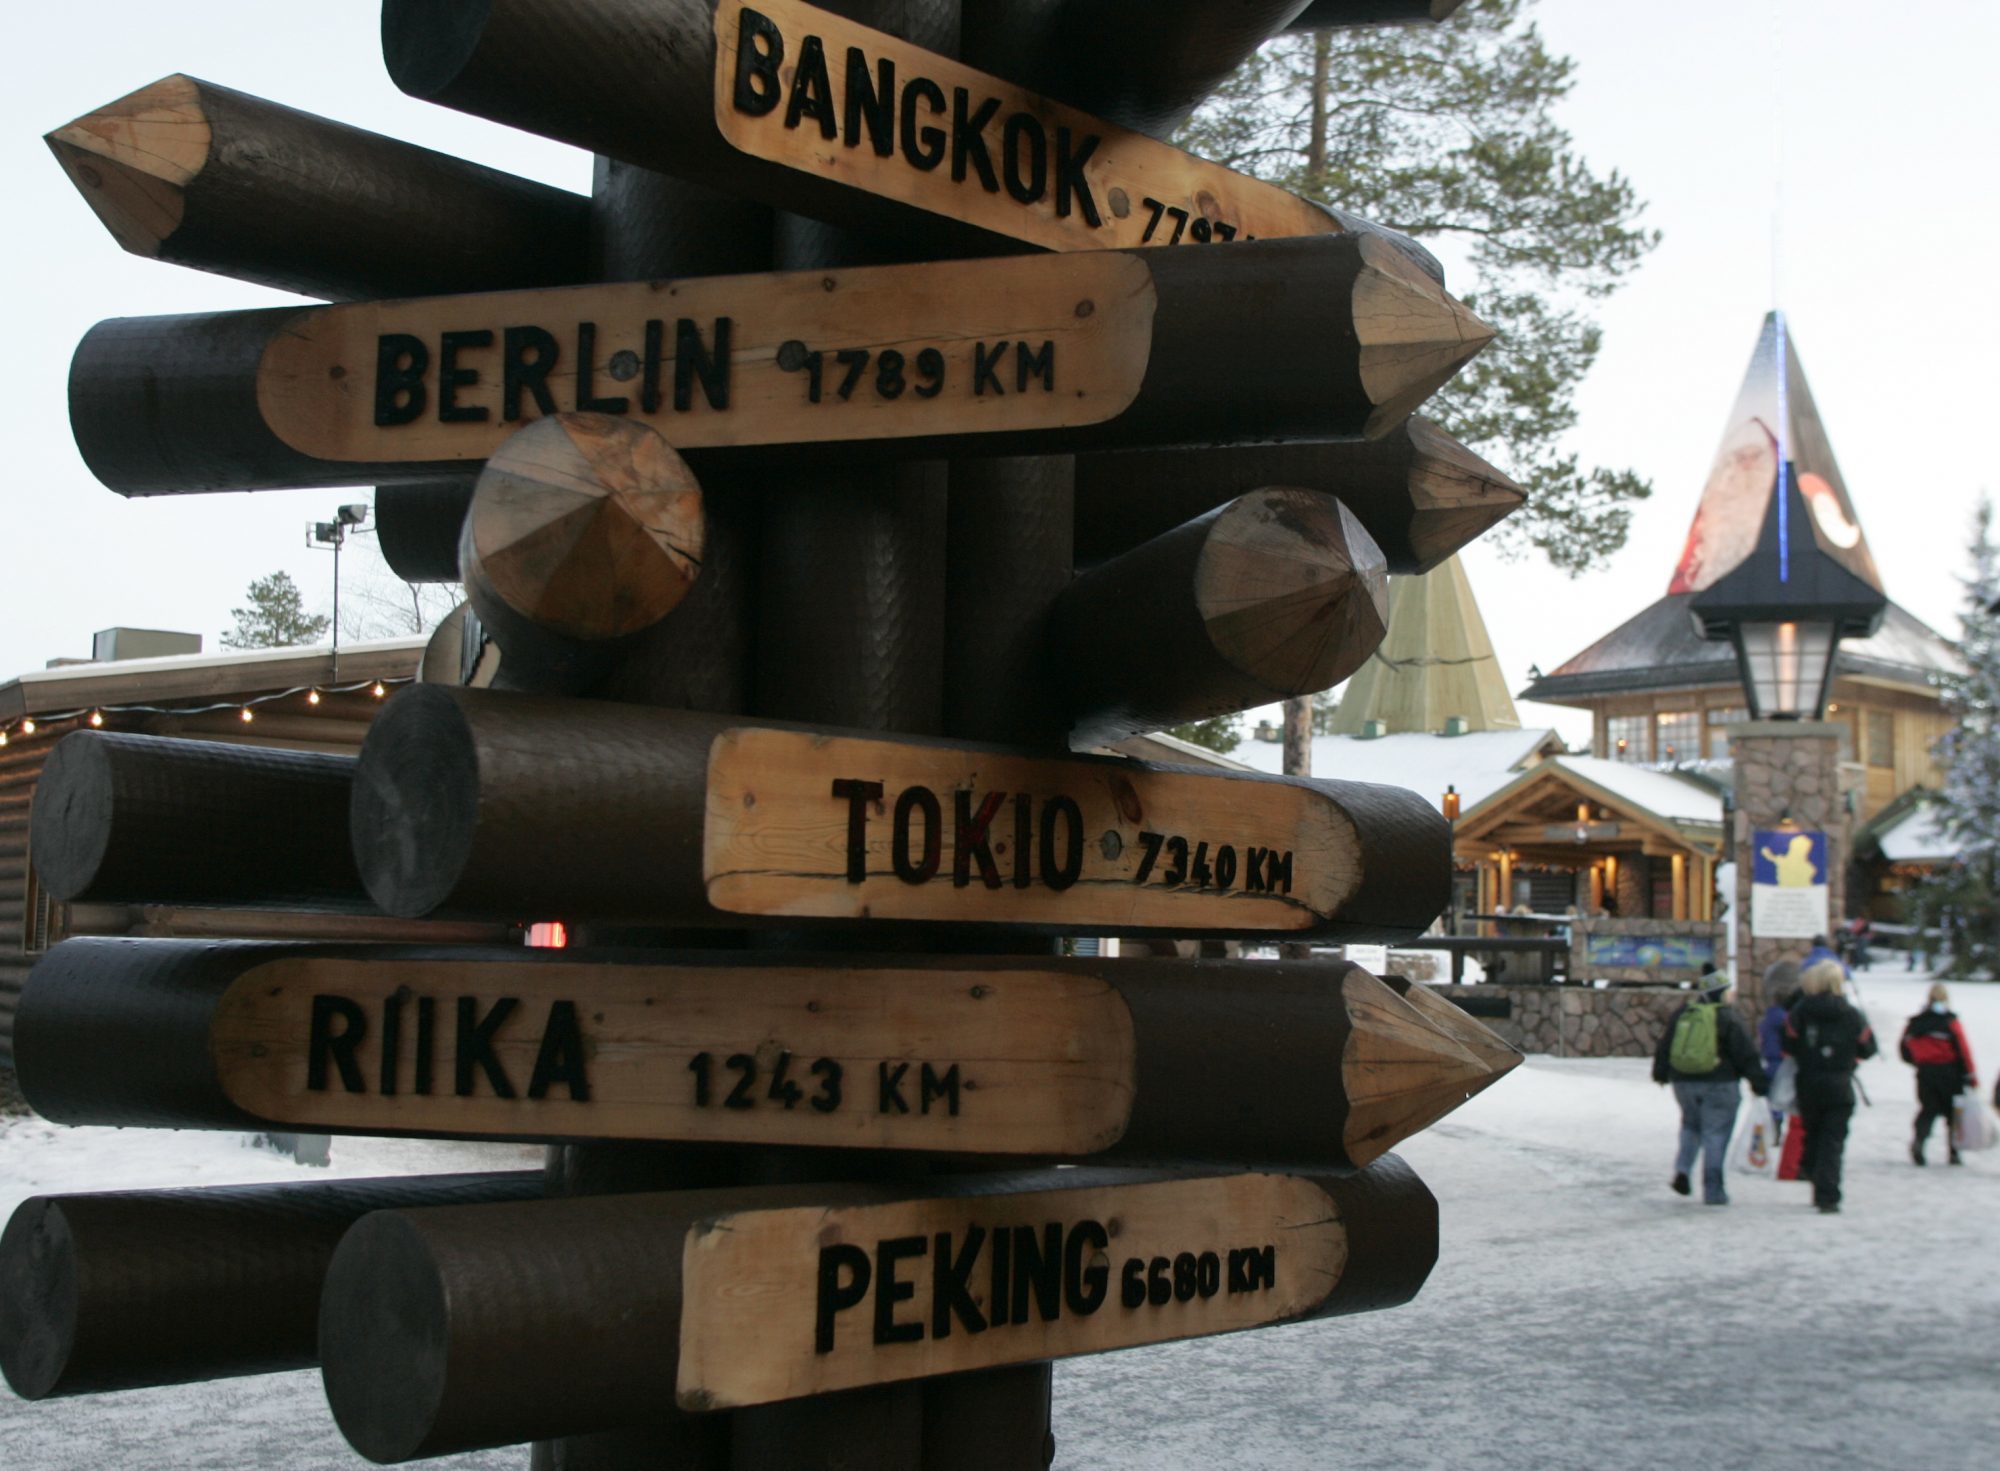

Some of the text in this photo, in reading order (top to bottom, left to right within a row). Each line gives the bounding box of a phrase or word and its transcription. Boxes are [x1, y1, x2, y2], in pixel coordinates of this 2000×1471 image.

[733, 7, 1101, 227] BANGKOK
[375, 317, 1054, 426] BERLIN 1789 KM
[831, 778, 1293, 893] TOKIO 7340 KM
[307, 994, 960, 1116] RIIKA 1243 KM
[815, 1219, 1275, 1354] PEKING 6680 KM
